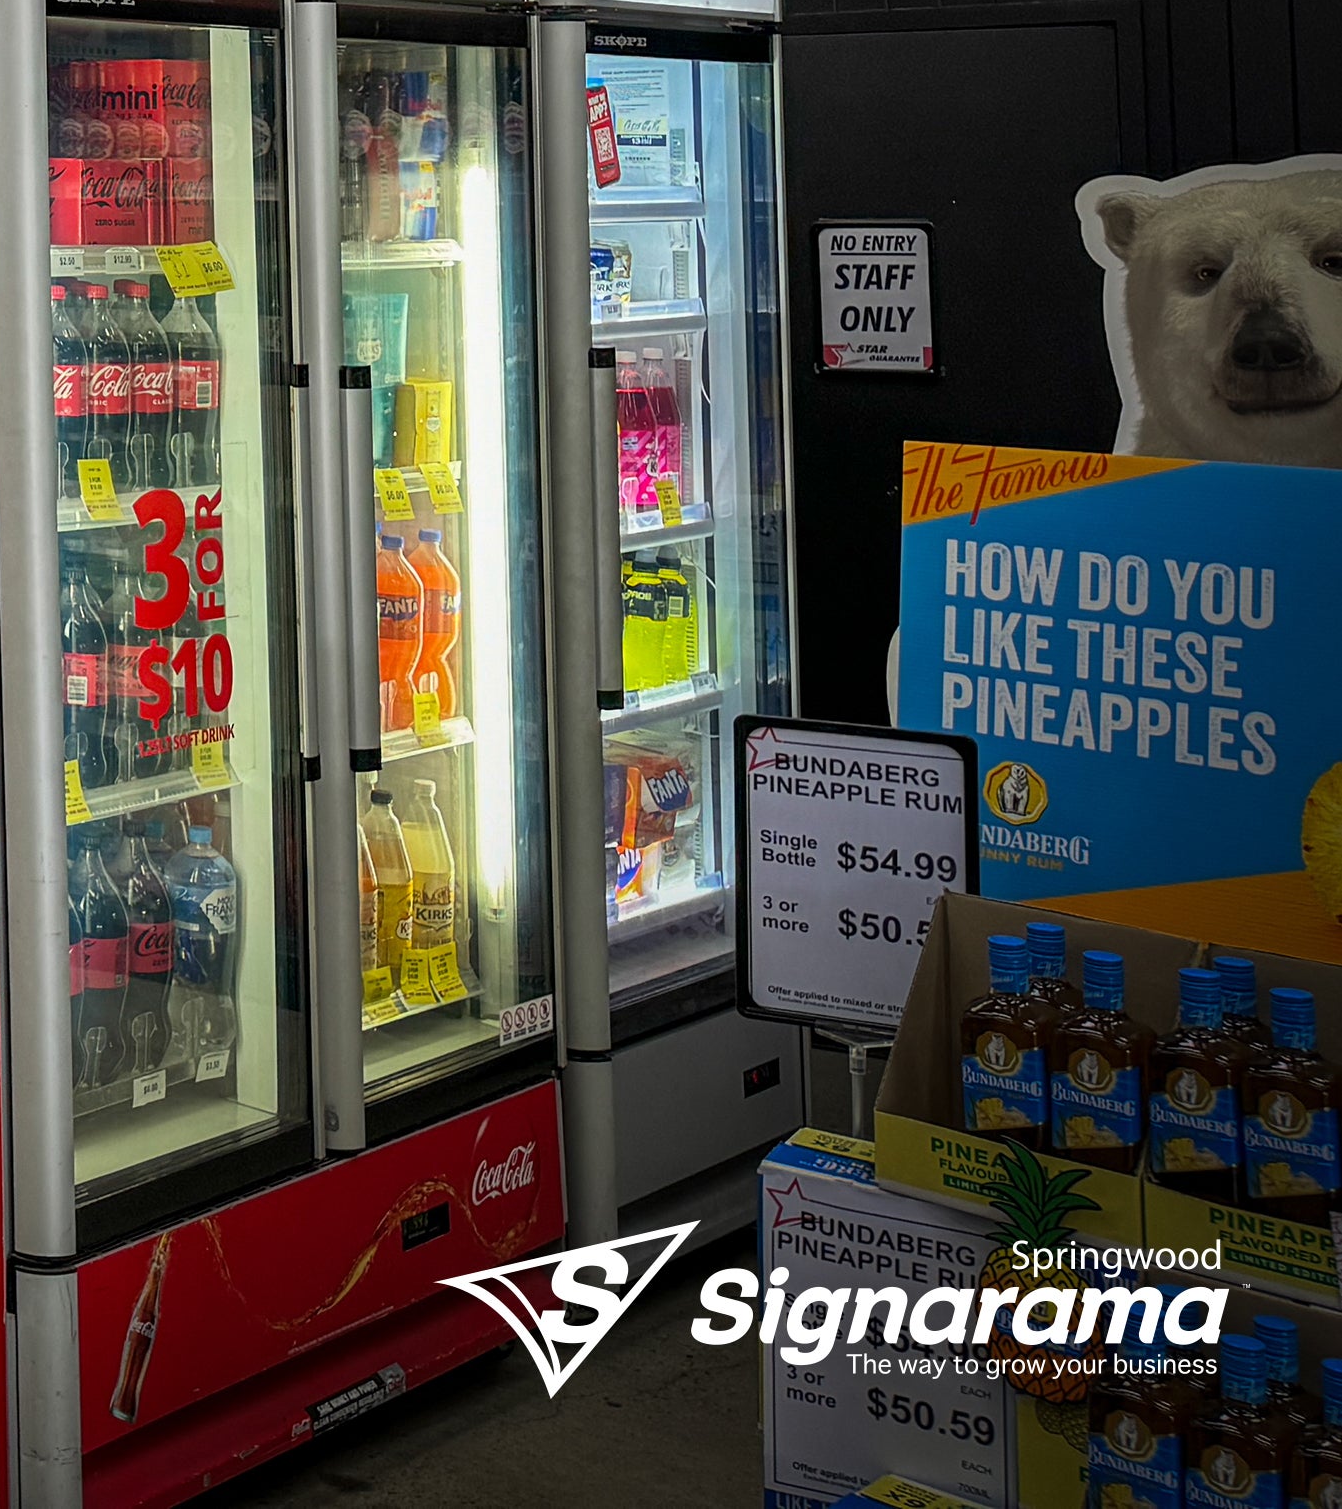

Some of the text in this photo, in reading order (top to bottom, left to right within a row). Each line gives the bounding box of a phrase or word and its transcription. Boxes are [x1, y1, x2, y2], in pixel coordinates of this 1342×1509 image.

[594, 35, 647, 47] SKOPE
[101, 84, 158, 110] mini
[831, 236, 917, 251] NO ENTRY
[835, 264, 915, 290] STAFF
[840, 306, 915, 332] ONLY
[857, 345, 888, 353] STAR
[904, 444, 1109, 526] The Famous
[133, 485, 226, 630] 3 FOR
[946, 538, 1275, 630] HOW DO YOU
[943, 604, 1243, 699] LIKE THESE
[138, 634, 233, 730] $10
[173, 723, 235, 750] SOFT DRINK
[942, 671, 1277, 776] PINEAPPLES
[775, 752, 940, 788] BUNDABERG
[648, 772, 686, 804] FANTA
[753, 774, 963, 814] PINEAPPLE RUM
[760, 830, 818, 850] Single
[762, 848, 816, 868] Bottle
[837, 841, 957, 883] $54.99
[416, 907, 452, 921] KIRKS
[763, 896, 799, 913] 3 or
[763, 918, 809, 932] more
[838, 908, 931, 947] $50.5
[768, 985, 791, 996] Offer
[794, 989, 829, 1002] applied
[831, 994, 840, 1003] to
[843, 998, 872, 1010] mixed
[875, 1001, 884, 1010] or
[961, 1061, 1043, 1098] BUNDABERG
[1051, 1078, 1136, 1117] BUNDABERG
[1149, 1099, 1237, 1139] BUNDABERG
[1244, 1124, 1335, 1162] BUNDABERG
[800, 1211, 975, 1267] BUNDABERG
[1220, 1231, 1322, 1266] FLAVOURED
[777, 1230, 929, 1284] PINEAPPLE
[787, 1365, 825, 1386] 3 or
[960, 1385, 992, 1400] EACH
[786, 1386, 837, 1408] more
[867, 1387, 995, 1446] $50.59
[961, 1460, 992, 1476] EACH
[1089, 1442, 1179, 1488] BUNDABERG
